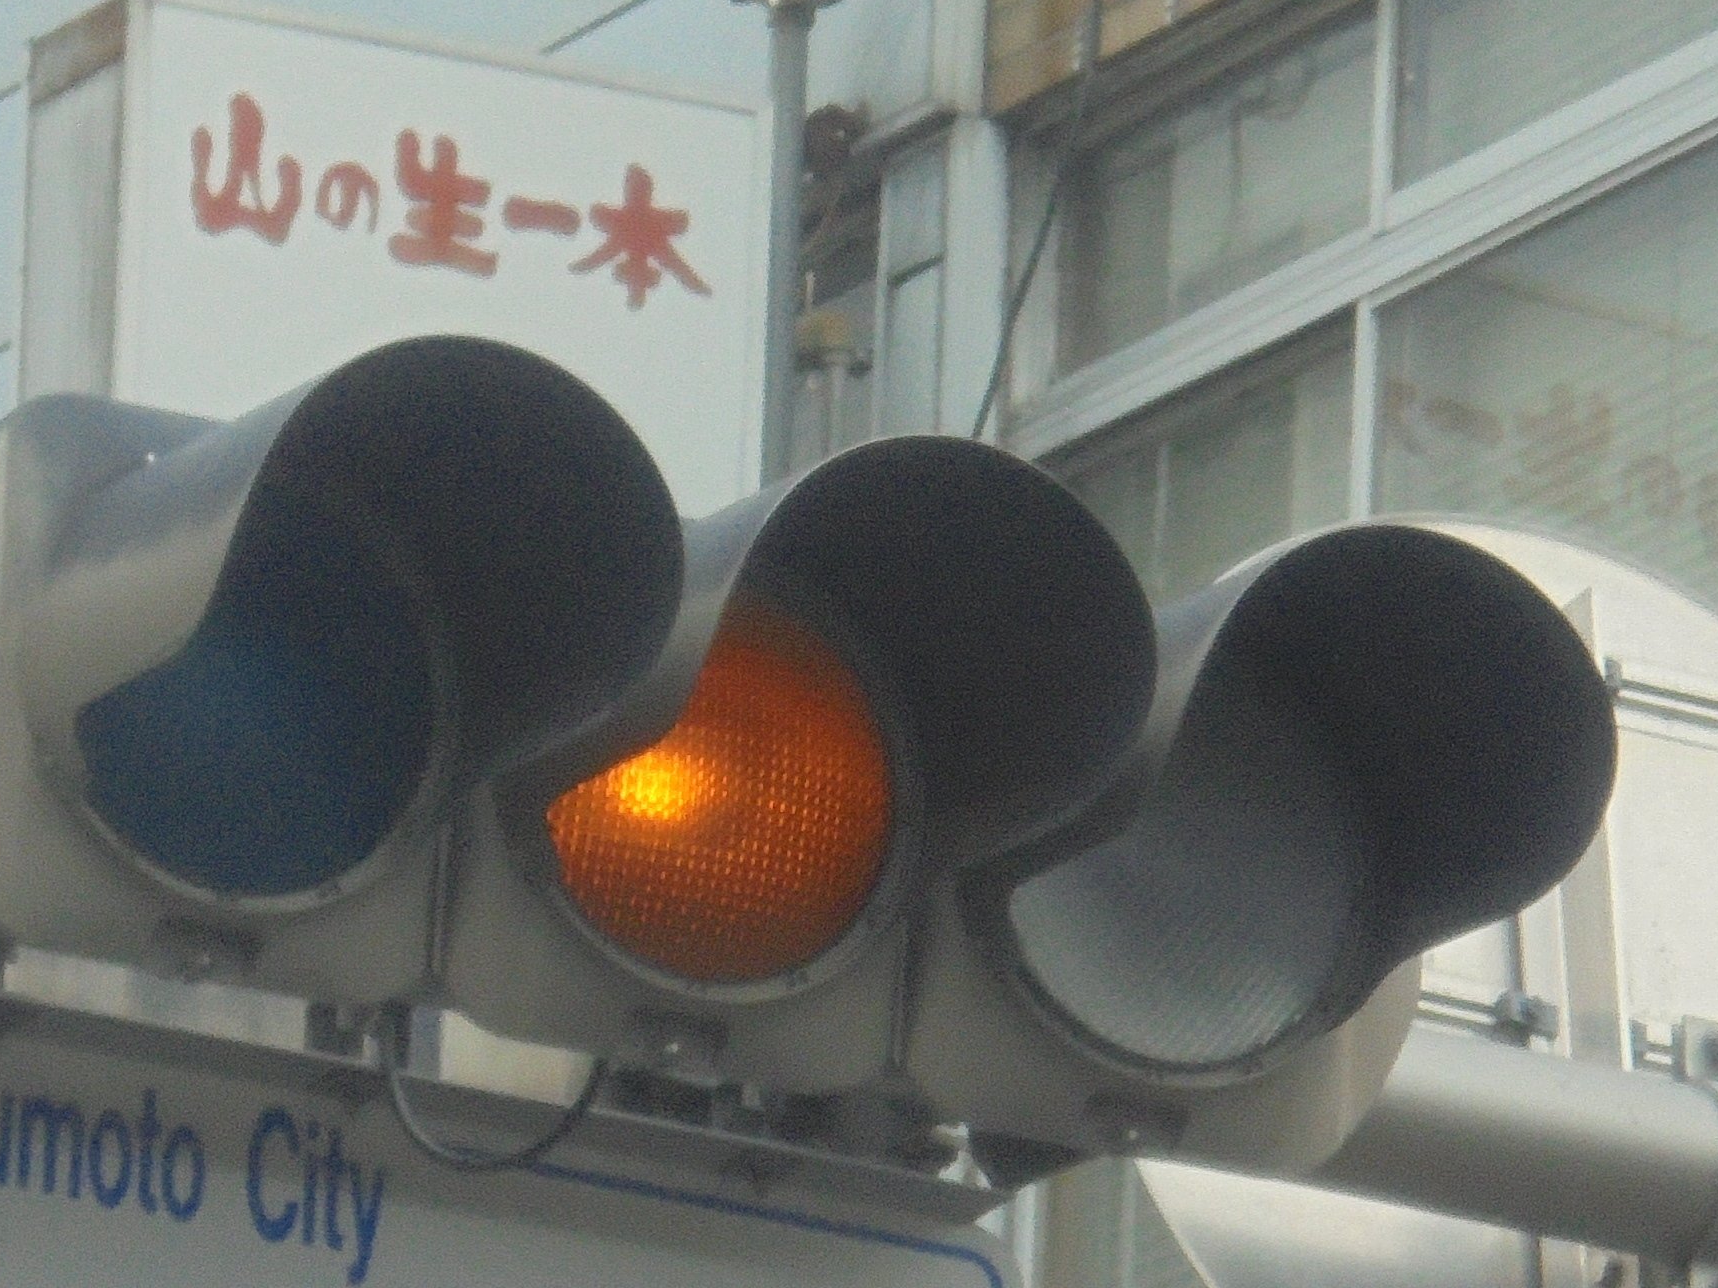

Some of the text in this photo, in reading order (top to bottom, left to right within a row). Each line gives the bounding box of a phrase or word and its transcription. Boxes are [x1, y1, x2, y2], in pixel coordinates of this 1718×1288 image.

[189, 90, 713, 311] 山の生一本
[244, 1105, 386, 1287] City
